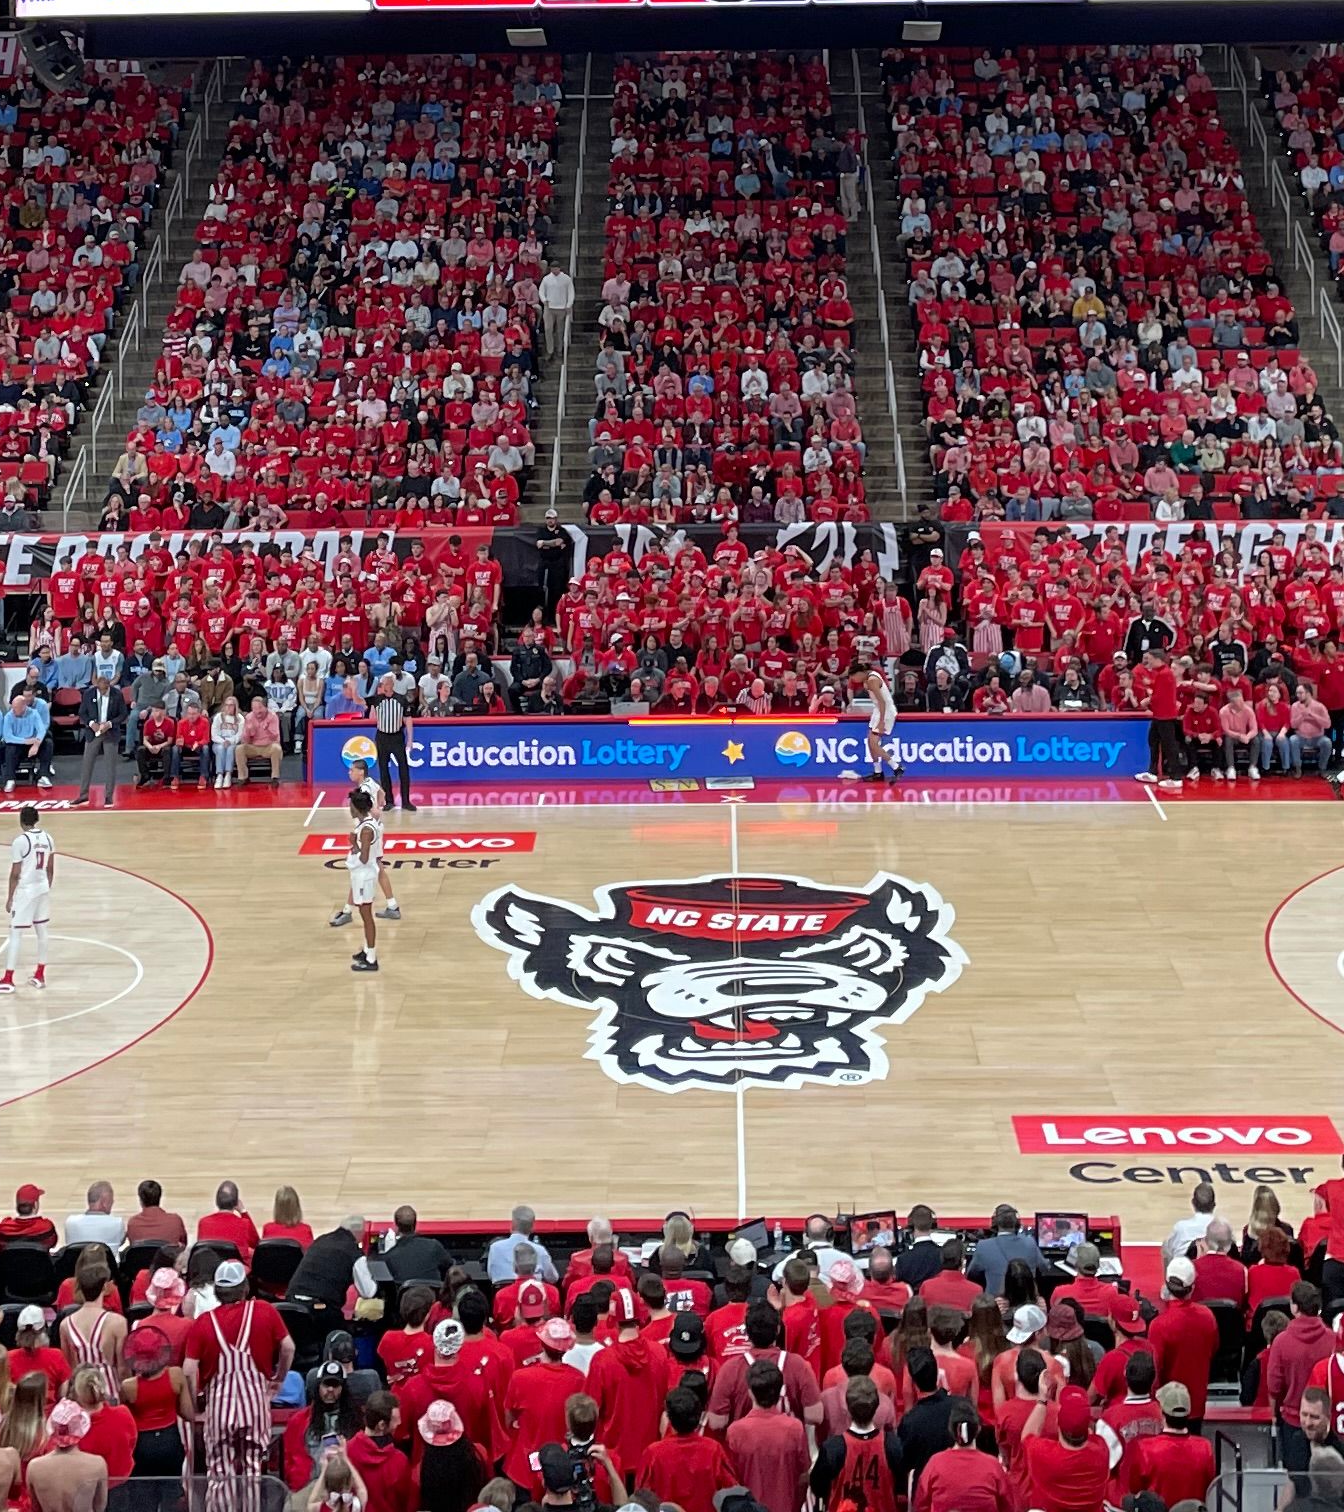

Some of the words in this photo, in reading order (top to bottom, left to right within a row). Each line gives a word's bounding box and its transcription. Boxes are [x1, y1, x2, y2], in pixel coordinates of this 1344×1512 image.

[430, 739, 576, 768] Education
[582, 739, 689, 771] Lottery
[816, 737, 857, 763] NC
[1017, 736, 1126, 769] Lottery
[322, 837, 516, 850] Lnovo
[646, 907, 702, 927] NC
[708, 913, 828, 932] STATE
[1042, 1122, 1313, 1145] Lenovo
[1069, 1161, 1315, 1184] Center
